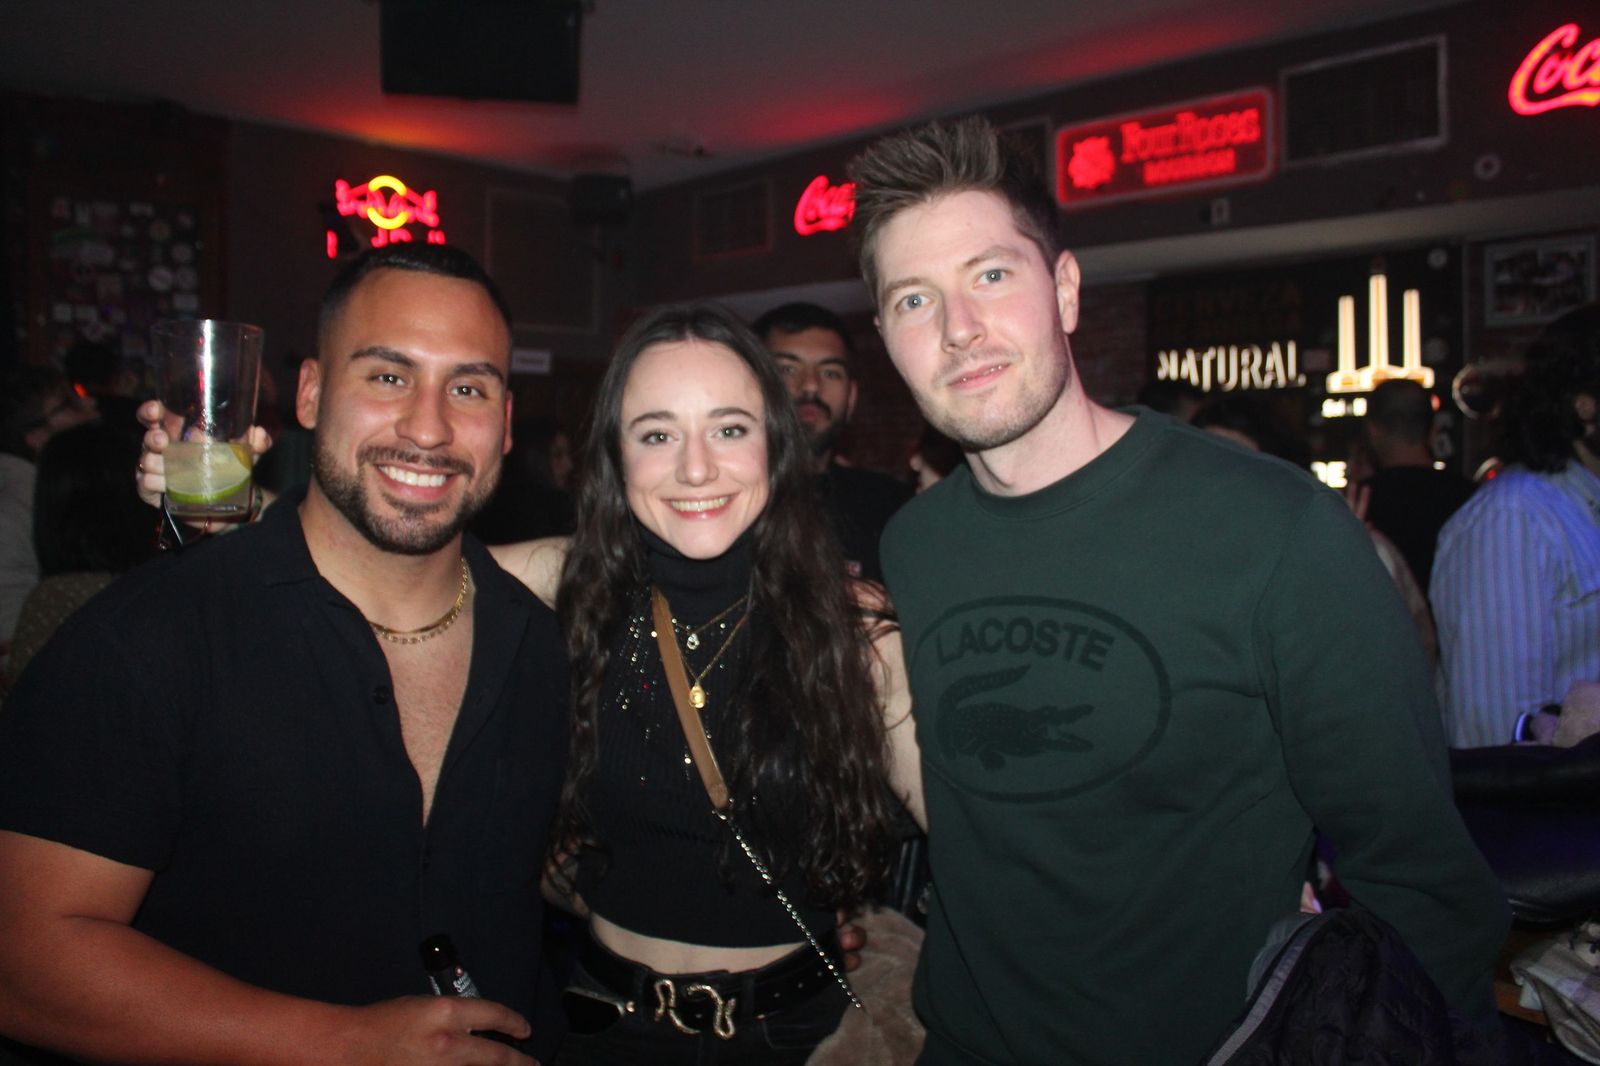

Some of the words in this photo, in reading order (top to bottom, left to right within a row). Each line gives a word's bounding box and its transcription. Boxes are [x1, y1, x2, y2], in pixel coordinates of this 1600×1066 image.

[1507, 23, 1600, 116] Coc
[1156, 339, 1307, 393] NATURAL
[935, 616, 1115, 673] LACOSTE
